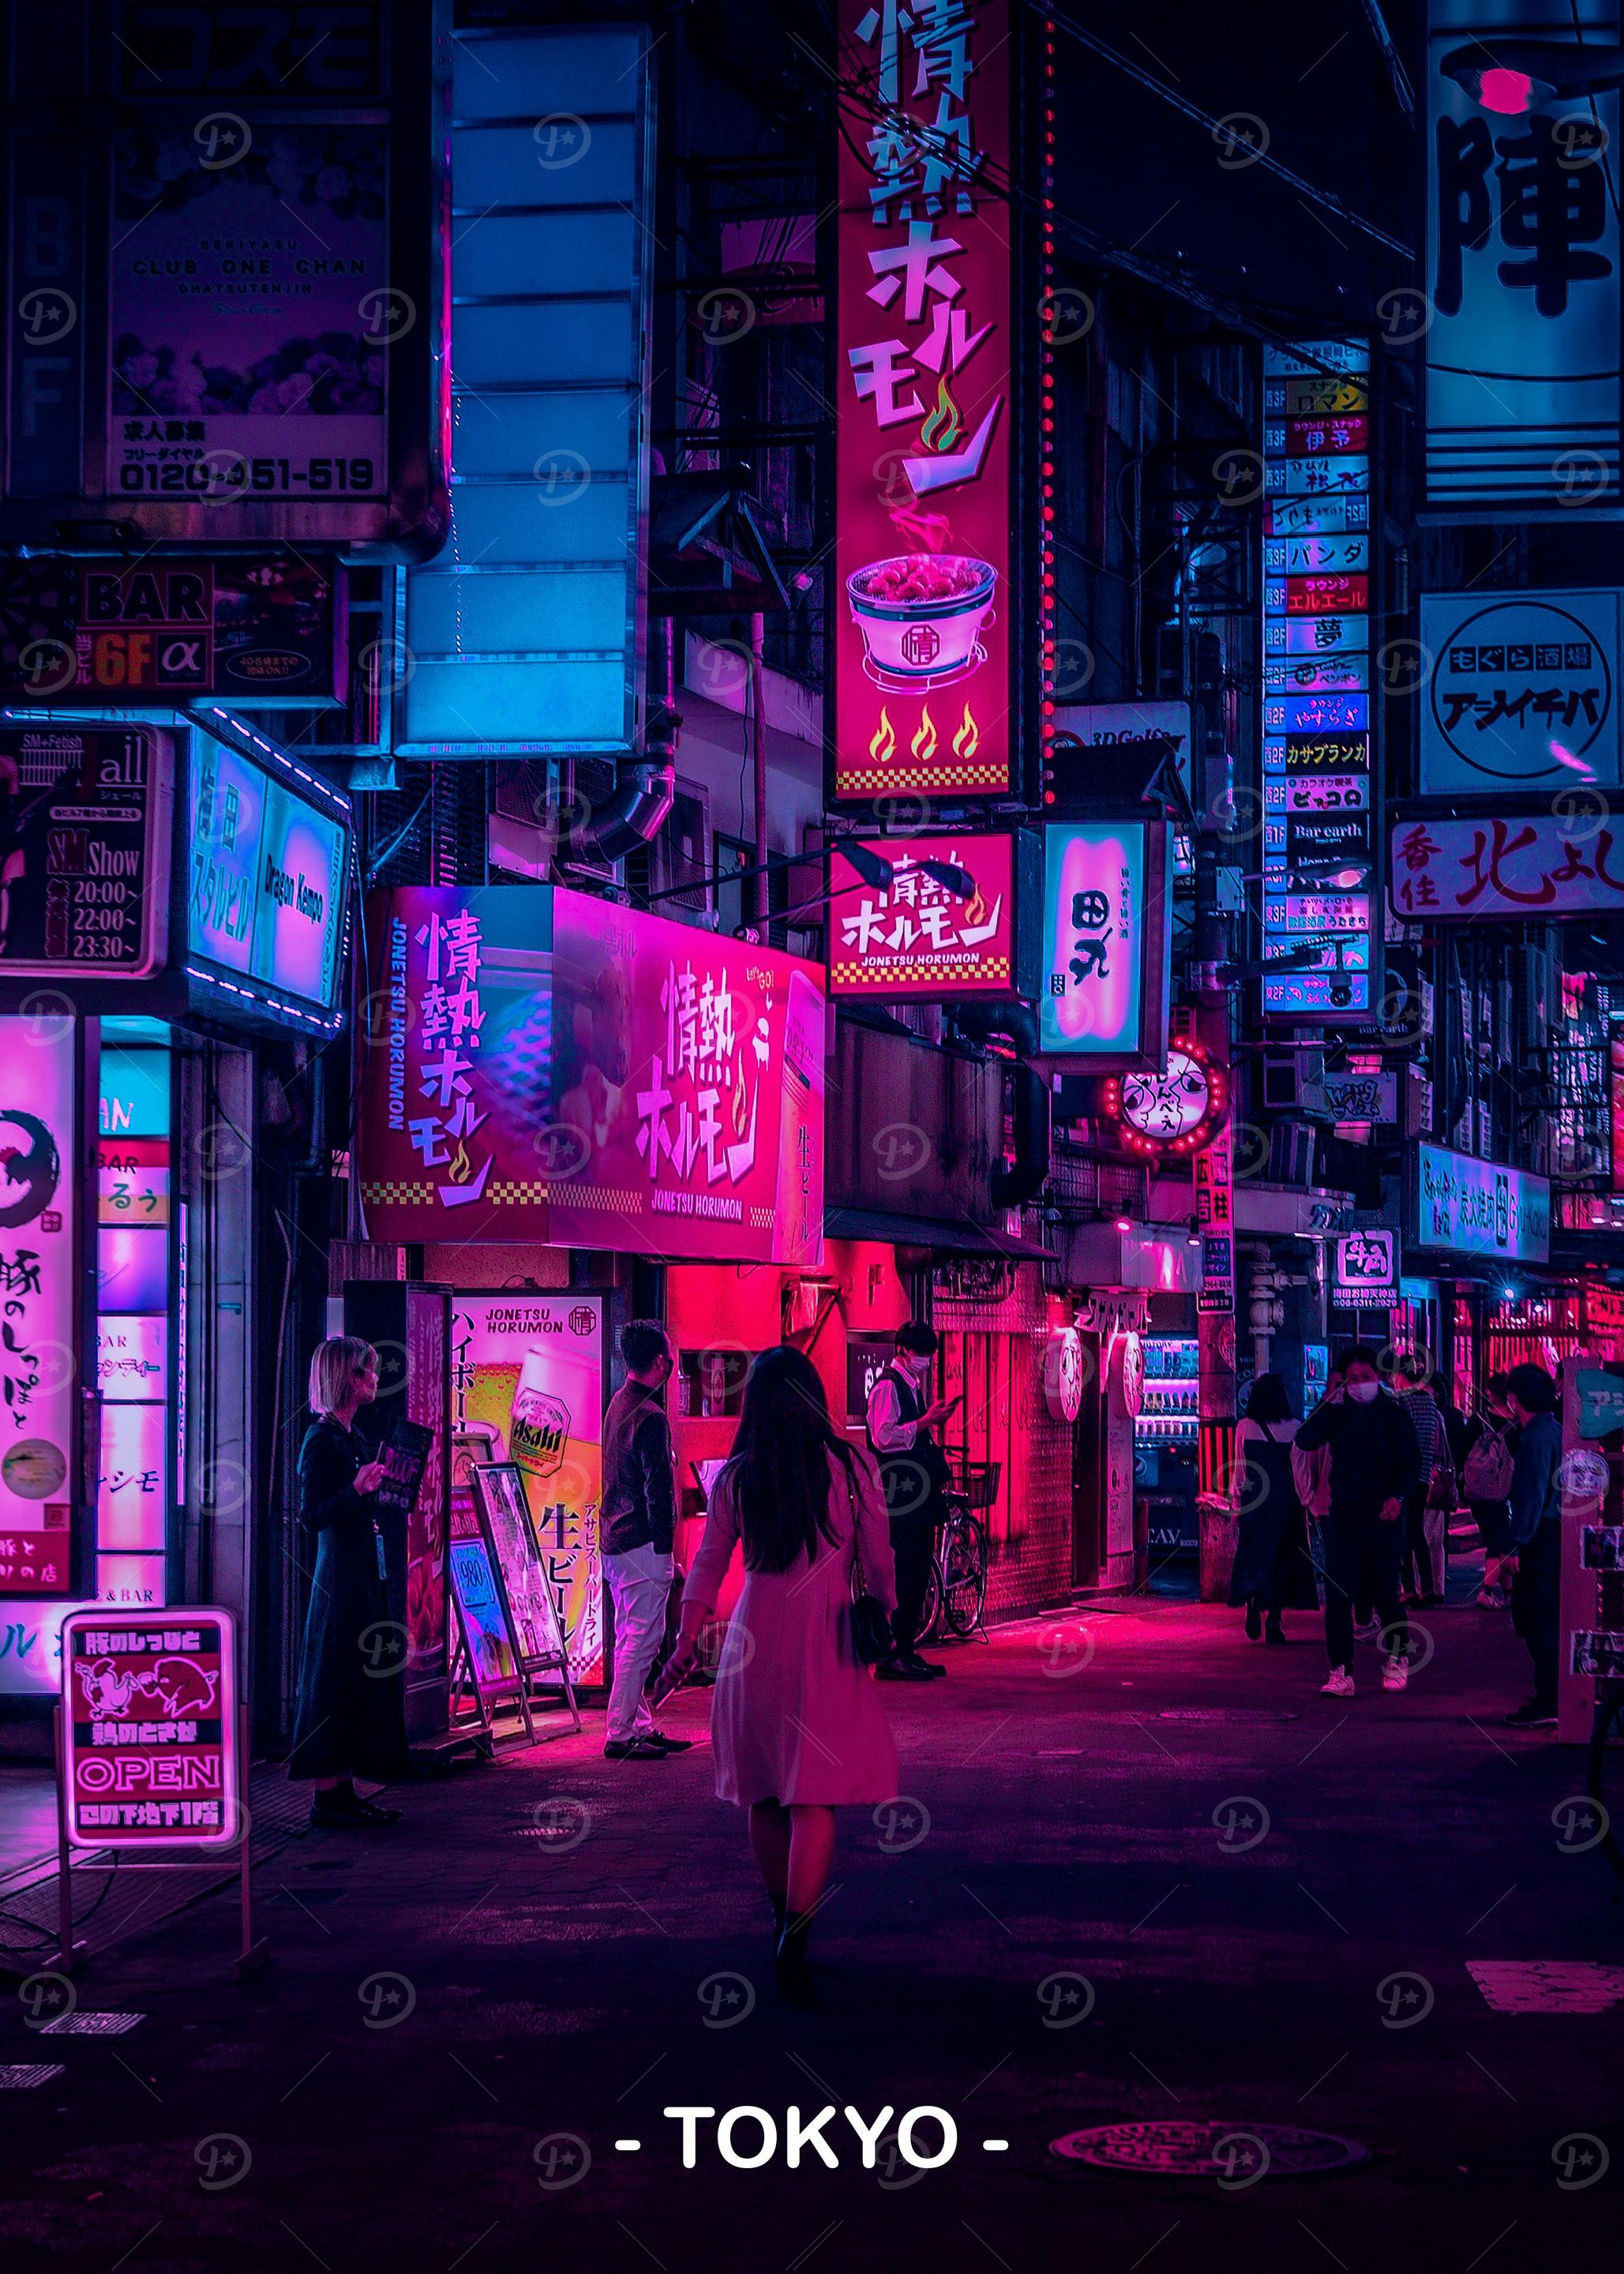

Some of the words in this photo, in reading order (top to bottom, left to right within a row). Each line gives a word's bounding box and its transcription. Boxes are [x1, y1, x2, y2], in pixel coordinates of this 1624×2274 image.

[1433, 114, 1613, 319] 陣
[133, 259, 198, 275] CLUB
[222, 259, 272, 275] ONE
[296, 258, 366, 274] CHAN
[1297, 392, 1360, 412] ロマン
[85, 572, 208, 622] BAR
[1288, 591, 1366, 610] エルエール
[96, 633, 152, 685] 6F
[1450, 643, 1592, 674] もぐら酒場
[1287, 742, 1367, 764] カサブランカ
[264, 853, 295, 909] Dragon
[295, 872, 324, 925] Kempo
[840, 893, 1002, 954] ホルモン
[389, 916, 407, 1011] JONETSU
[861, 955, 914, 967] JONETSU
[917, 952, 980, 966] HORUMON
[660, 959, 736, 1088] 情熱
[388, 1015, 406, 1131] HORUMON
[408, 908, 495, 1209] 情熱ホルモン
[635, 1054, 759, 1184] ホルモン
[797, 1124, 812, 1243] 生ビール
[651, 1188, 694, 1216] JONETSU
[696, 1194, 743, 1221] HORUMON
[485, 1308, 551, 1321] JONETSU
[486, 1321, 564, 1334] HORUMON
[513, 1416, 563, 1454] Asahi
[120, 1589, 154, 1602] BAR
[77, 1754, 220, 1792] OPEN
